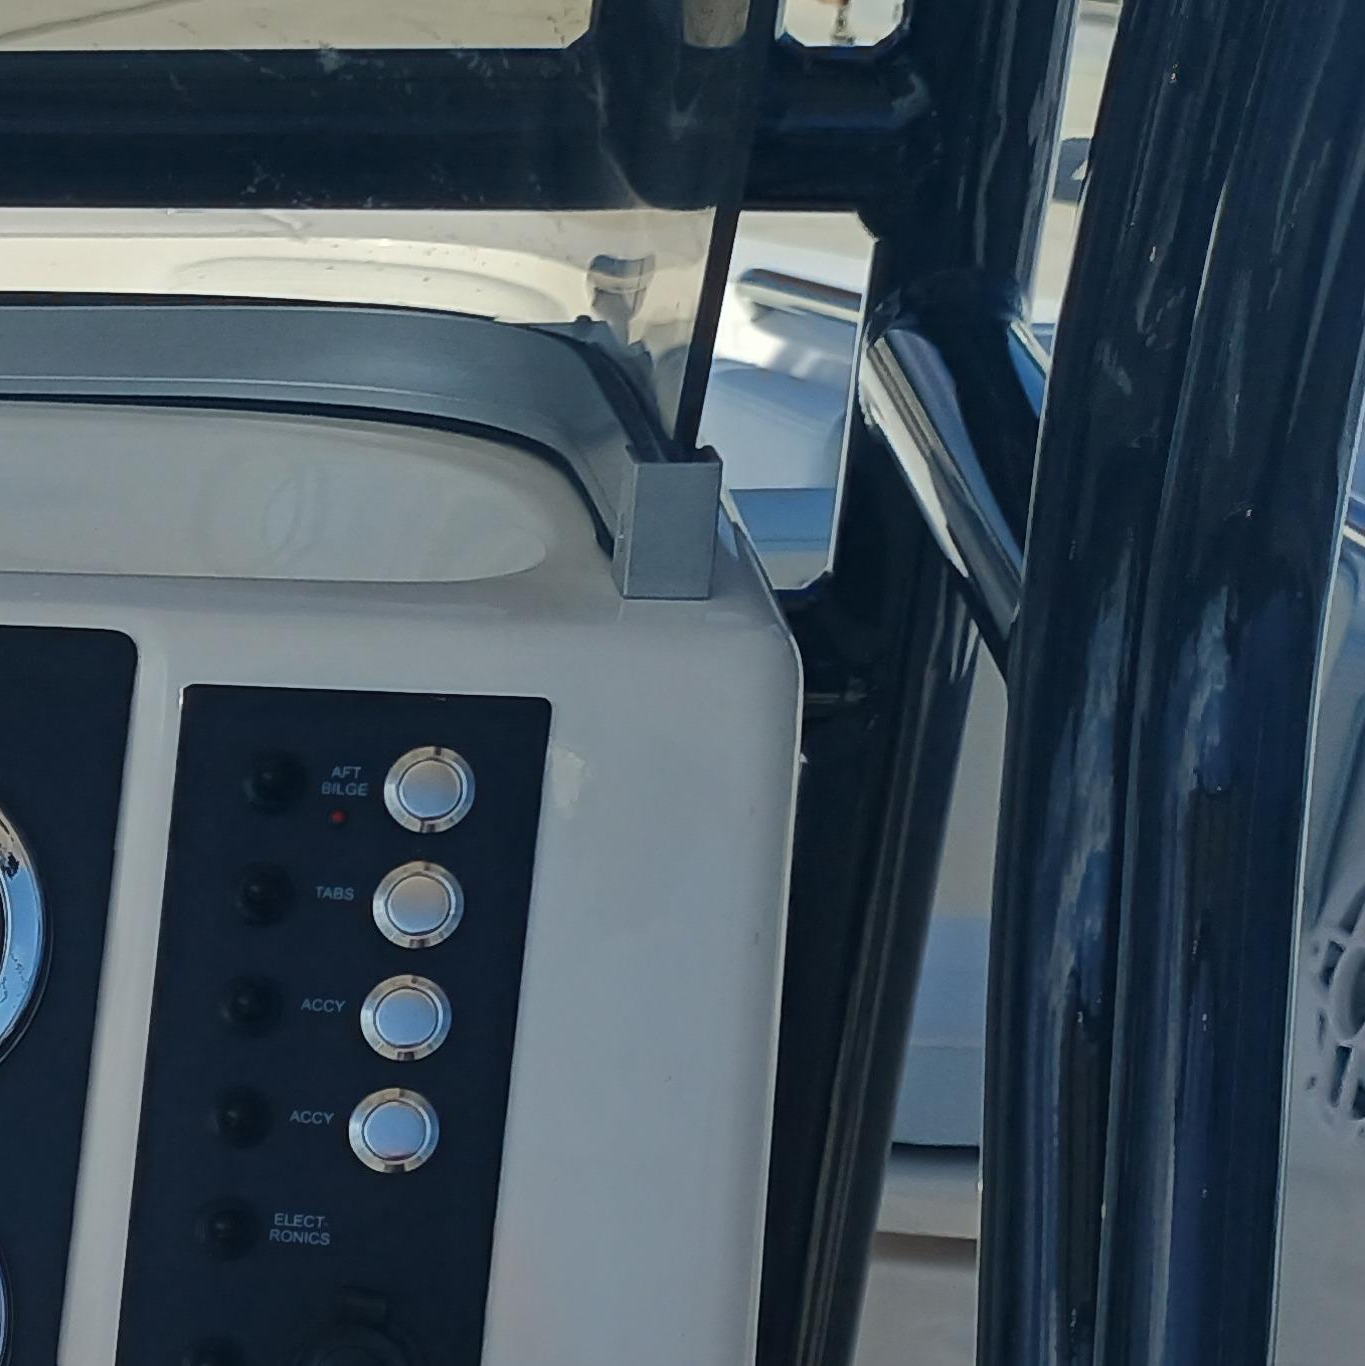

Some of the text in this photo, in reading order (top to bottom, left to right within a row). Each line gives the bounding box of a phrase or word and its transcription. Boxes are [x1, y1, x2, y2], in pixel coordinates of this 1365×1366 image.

[331, 766, 362, 779] AFT
[321, 781, 368, 796] BILGE
[316, 886, 354, 901] TABS
[300, 998, 346, 1013] ACCY
[289, 1110, 335, 1124] ACCY
[269, 1228, 331, 1245] RONICS
